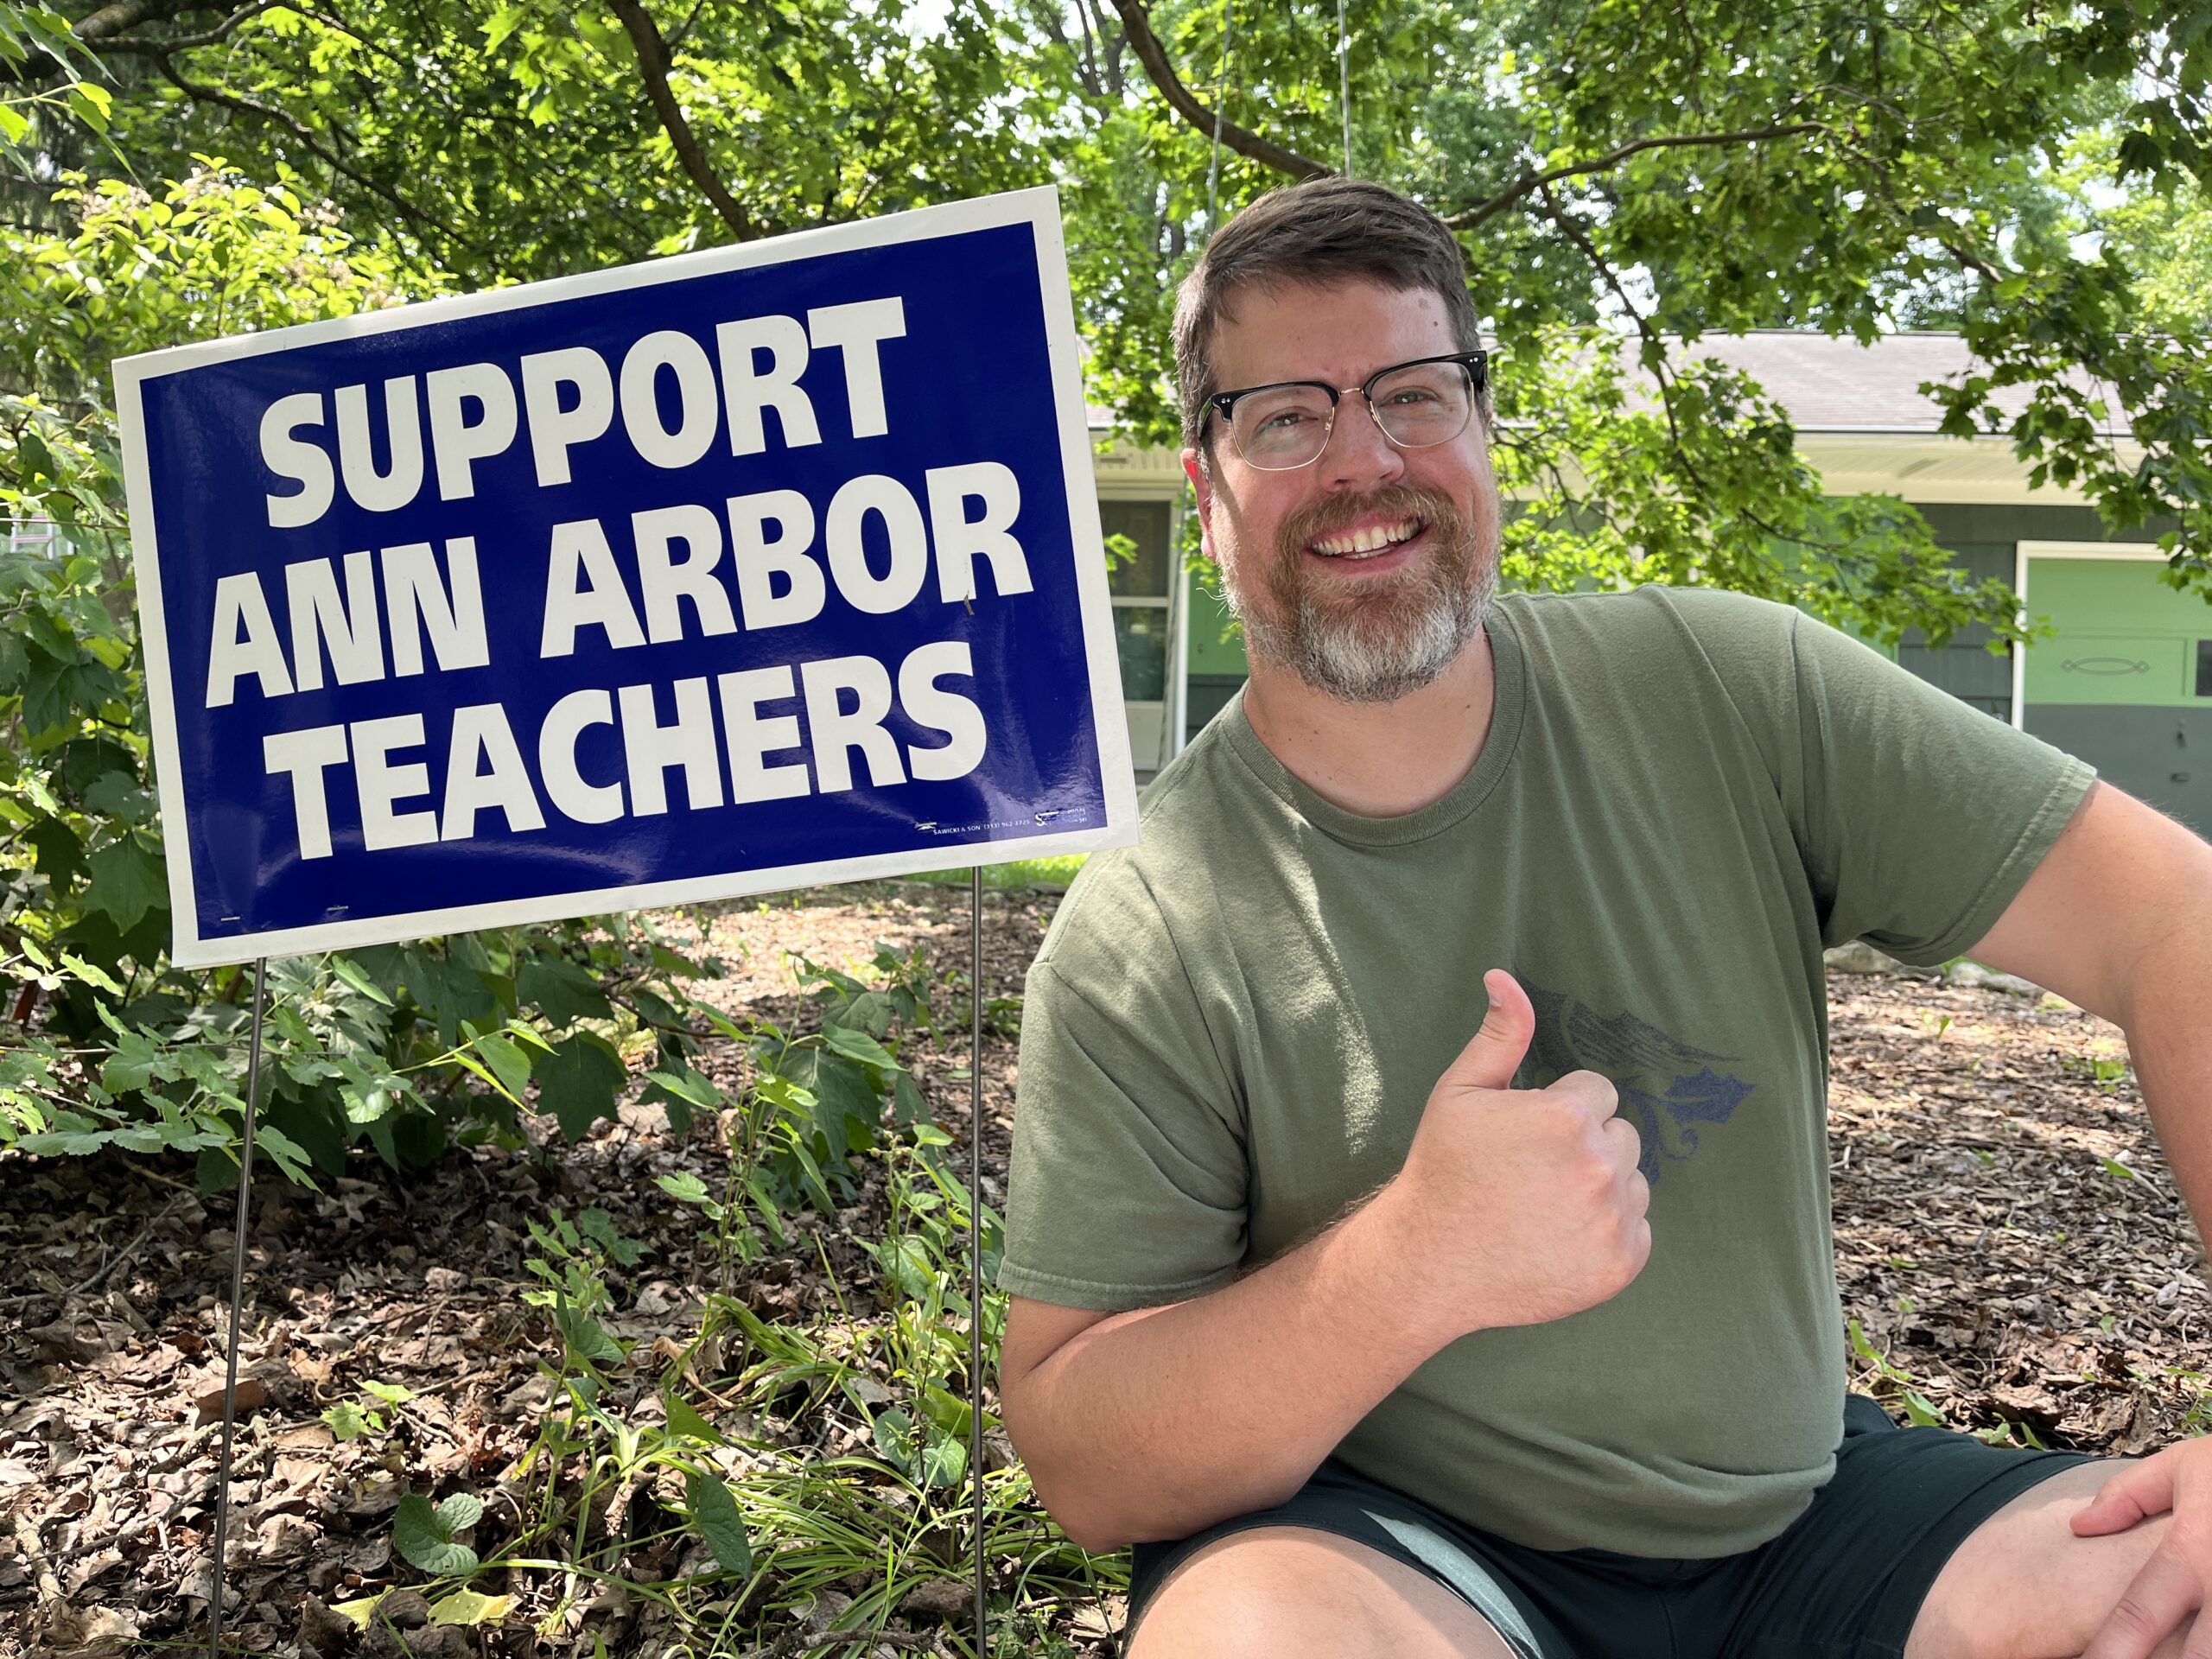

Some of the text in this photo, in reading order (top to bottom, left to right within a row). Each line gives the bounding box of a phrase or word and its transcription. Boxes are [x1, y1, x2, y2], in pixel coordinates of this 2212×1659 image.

[260, 296, 906, 527] SUPPORT
[207, 462, 1033, 708] ANN ARBOR
[264, 641, 986, 860] TEACHERS
[933, 827, 960, 836] SAWICKI
